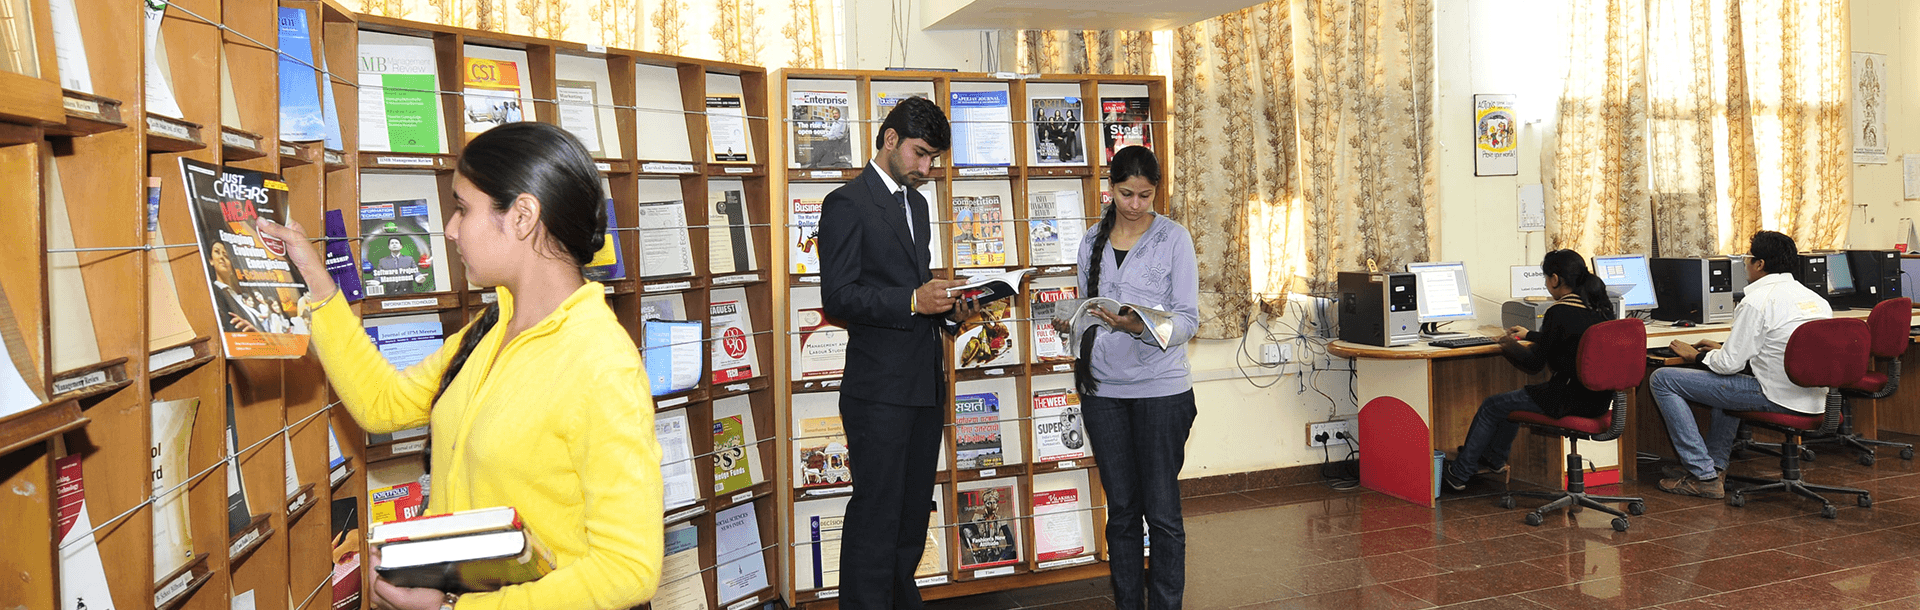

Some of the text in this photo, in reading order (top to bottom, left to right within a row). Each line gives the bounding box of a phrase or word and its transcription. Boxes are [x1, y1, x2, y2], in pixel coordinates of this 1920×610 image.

[391, 64, 426, 74] Review
[472, 64, 496, 81] CSI
[804, 94, 848, 105] Enterprise
[220, 173, 244, 184] JUST
[214, 180, 269, 204] CAREERS
[953, 197, 999, 206] competition
[220, 200, 258, 222] MBA
[1047, 395, 1067, 407] WEEK
